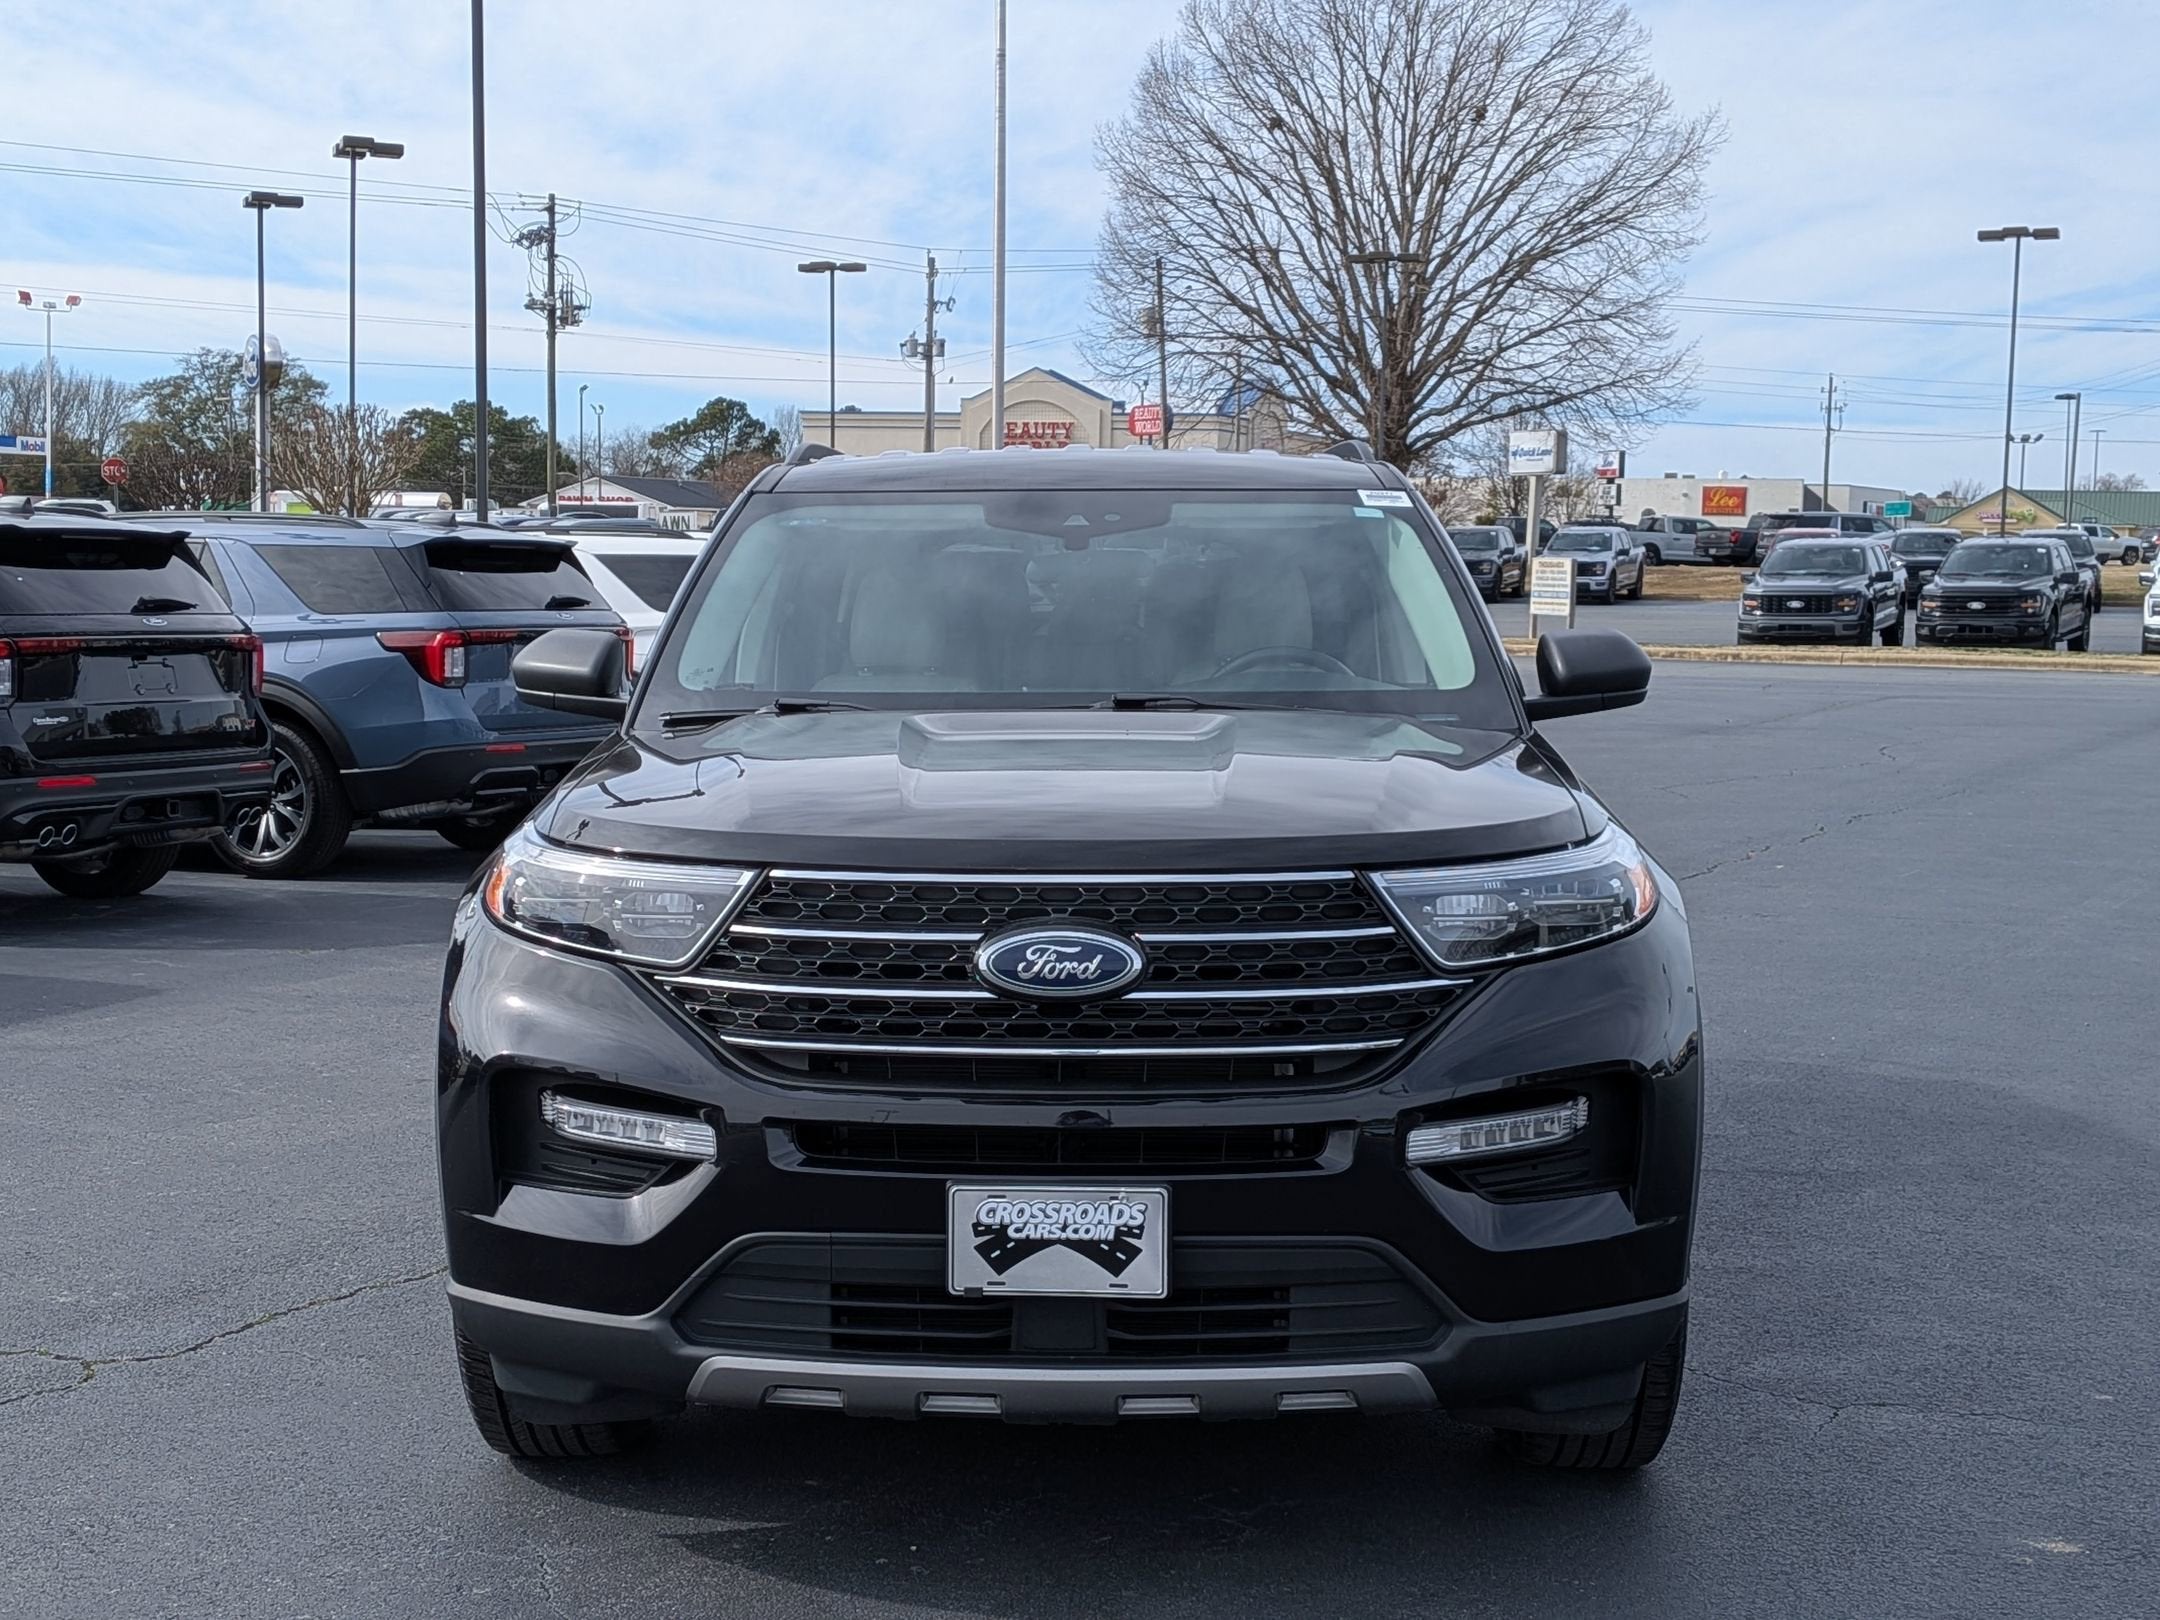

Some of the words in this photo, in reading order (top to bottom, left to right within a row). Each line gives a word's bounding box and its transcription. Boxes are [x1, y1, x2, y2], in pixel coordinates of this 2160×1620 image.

[1003, 422, 1074, 439] EAUTY
[21, 439, 46, 452] Mobil
[1705, 488, 1739, 507] Lee
[1016, 944, 1104, 980] Ford
[977, 1200, 1147, 1227] CROSSROADS
[1007, 1223, 1117, 1241] CARS.COM
